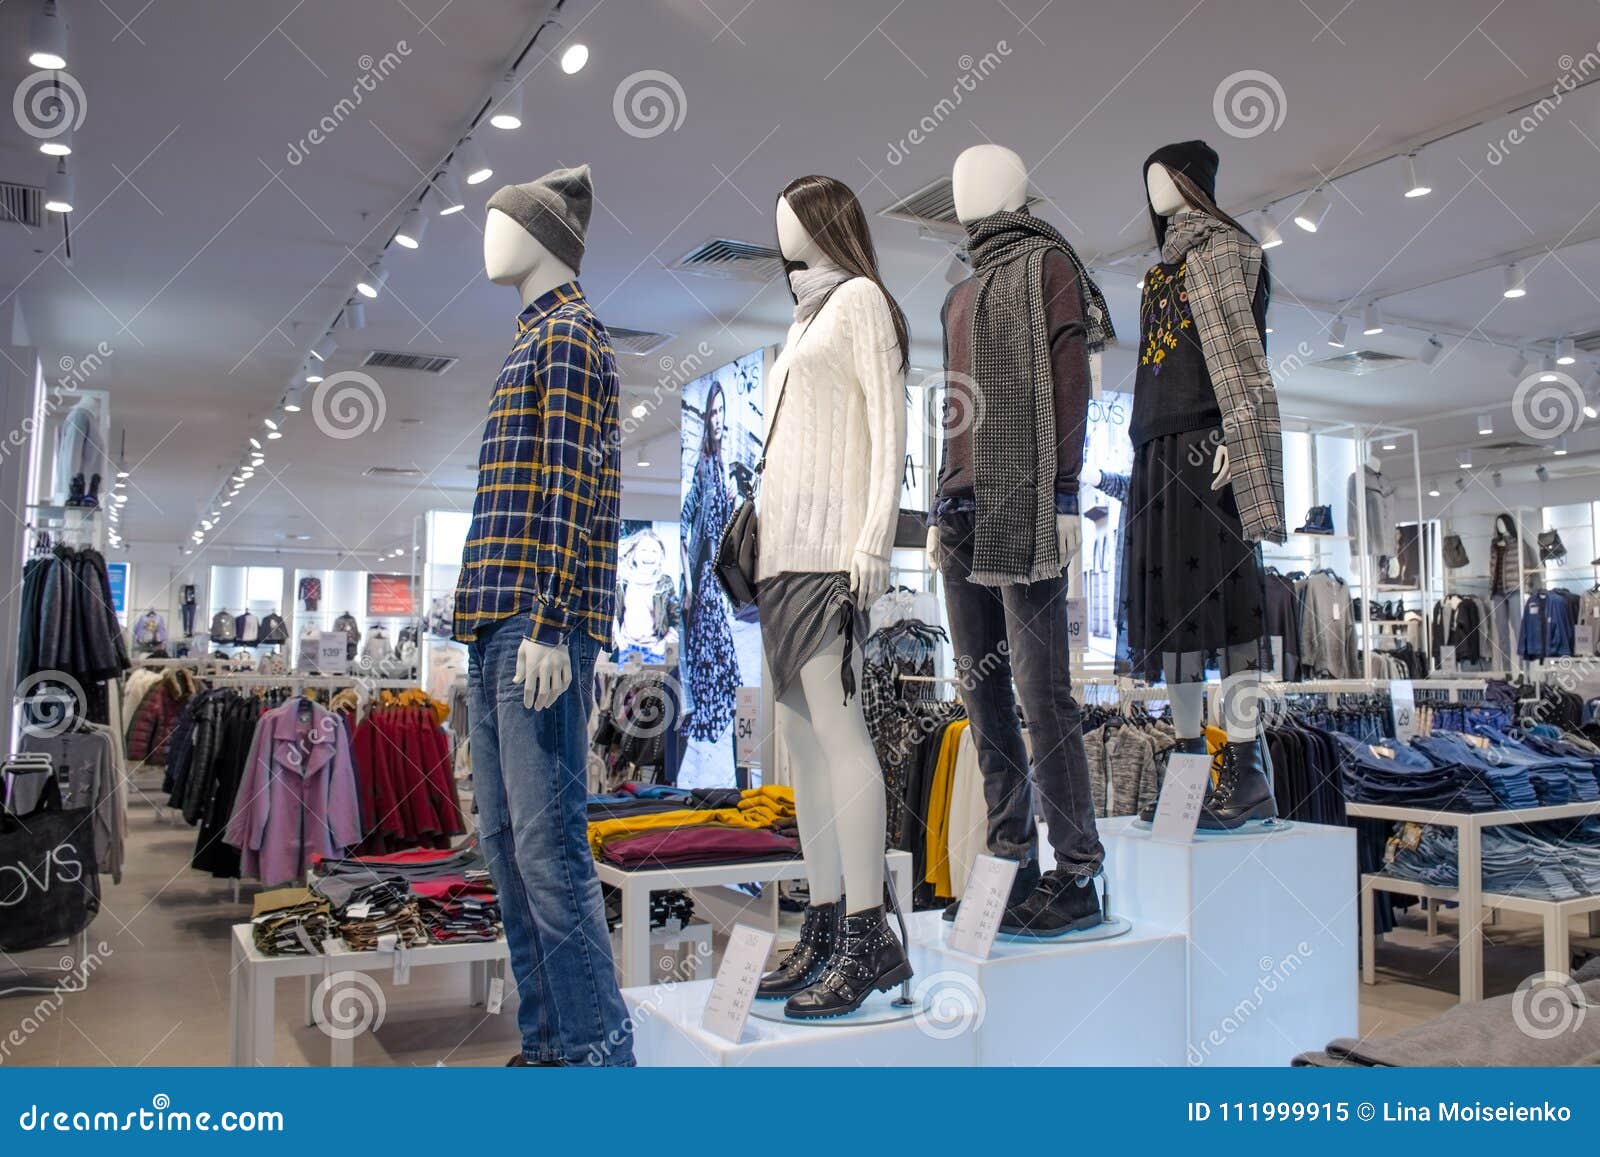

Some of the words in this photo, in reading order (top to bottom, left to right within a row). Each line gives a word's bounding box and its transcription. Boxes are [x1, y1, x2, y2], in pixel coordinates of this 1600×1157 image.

[1087, 402, 1125, 426] OVS
[738, 718, 752, 739] 54
[0, 843, 83, 906] OVS
